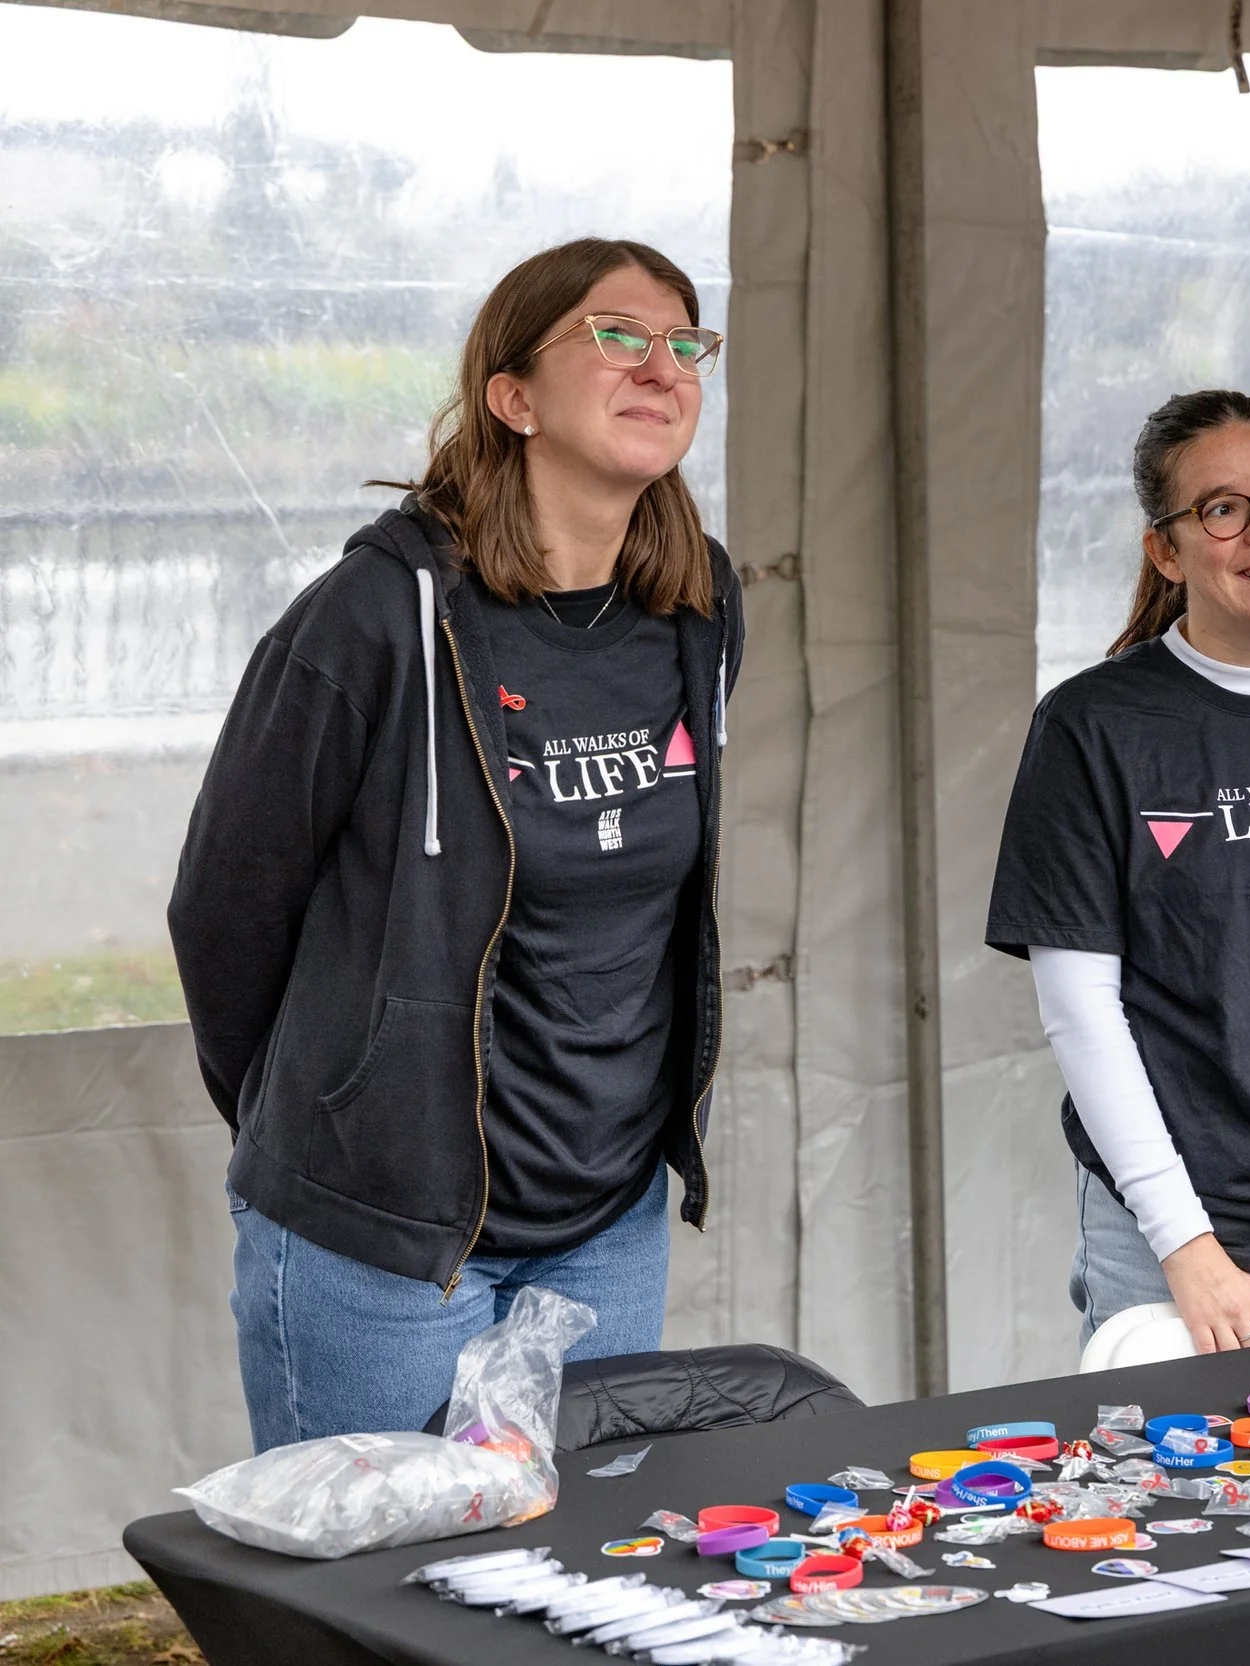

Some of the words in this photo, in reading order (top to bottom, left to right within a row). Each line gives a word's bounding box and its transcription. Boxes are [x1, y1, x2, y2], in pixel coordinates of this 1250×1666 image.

[543, 740, 571, 756] ALL
[572, 733, 627, 753] WALKS
[629, 729, 649, 745] OF
[544, 745, 661, 802] LIFE
[1217, 787, 1245, 801] ALL
[599, 808, 622, 821] AIDS
[598, 817, 620, 831] WALK
[600, 837, 622, 851] WEST
[967, 1427, 1008, 1442] ey/Them
[1156, 1453, 1195, 1467] She/Her
[952, 1483, 988, 1507] She/He
[1051, 1535, 1087, 1548] ABOUT
[1090, 1537, 1108, 1548] ME
[1109, 1532, 1129, 1546] ASK
[794, 1581, 837, 1594] He/Him
